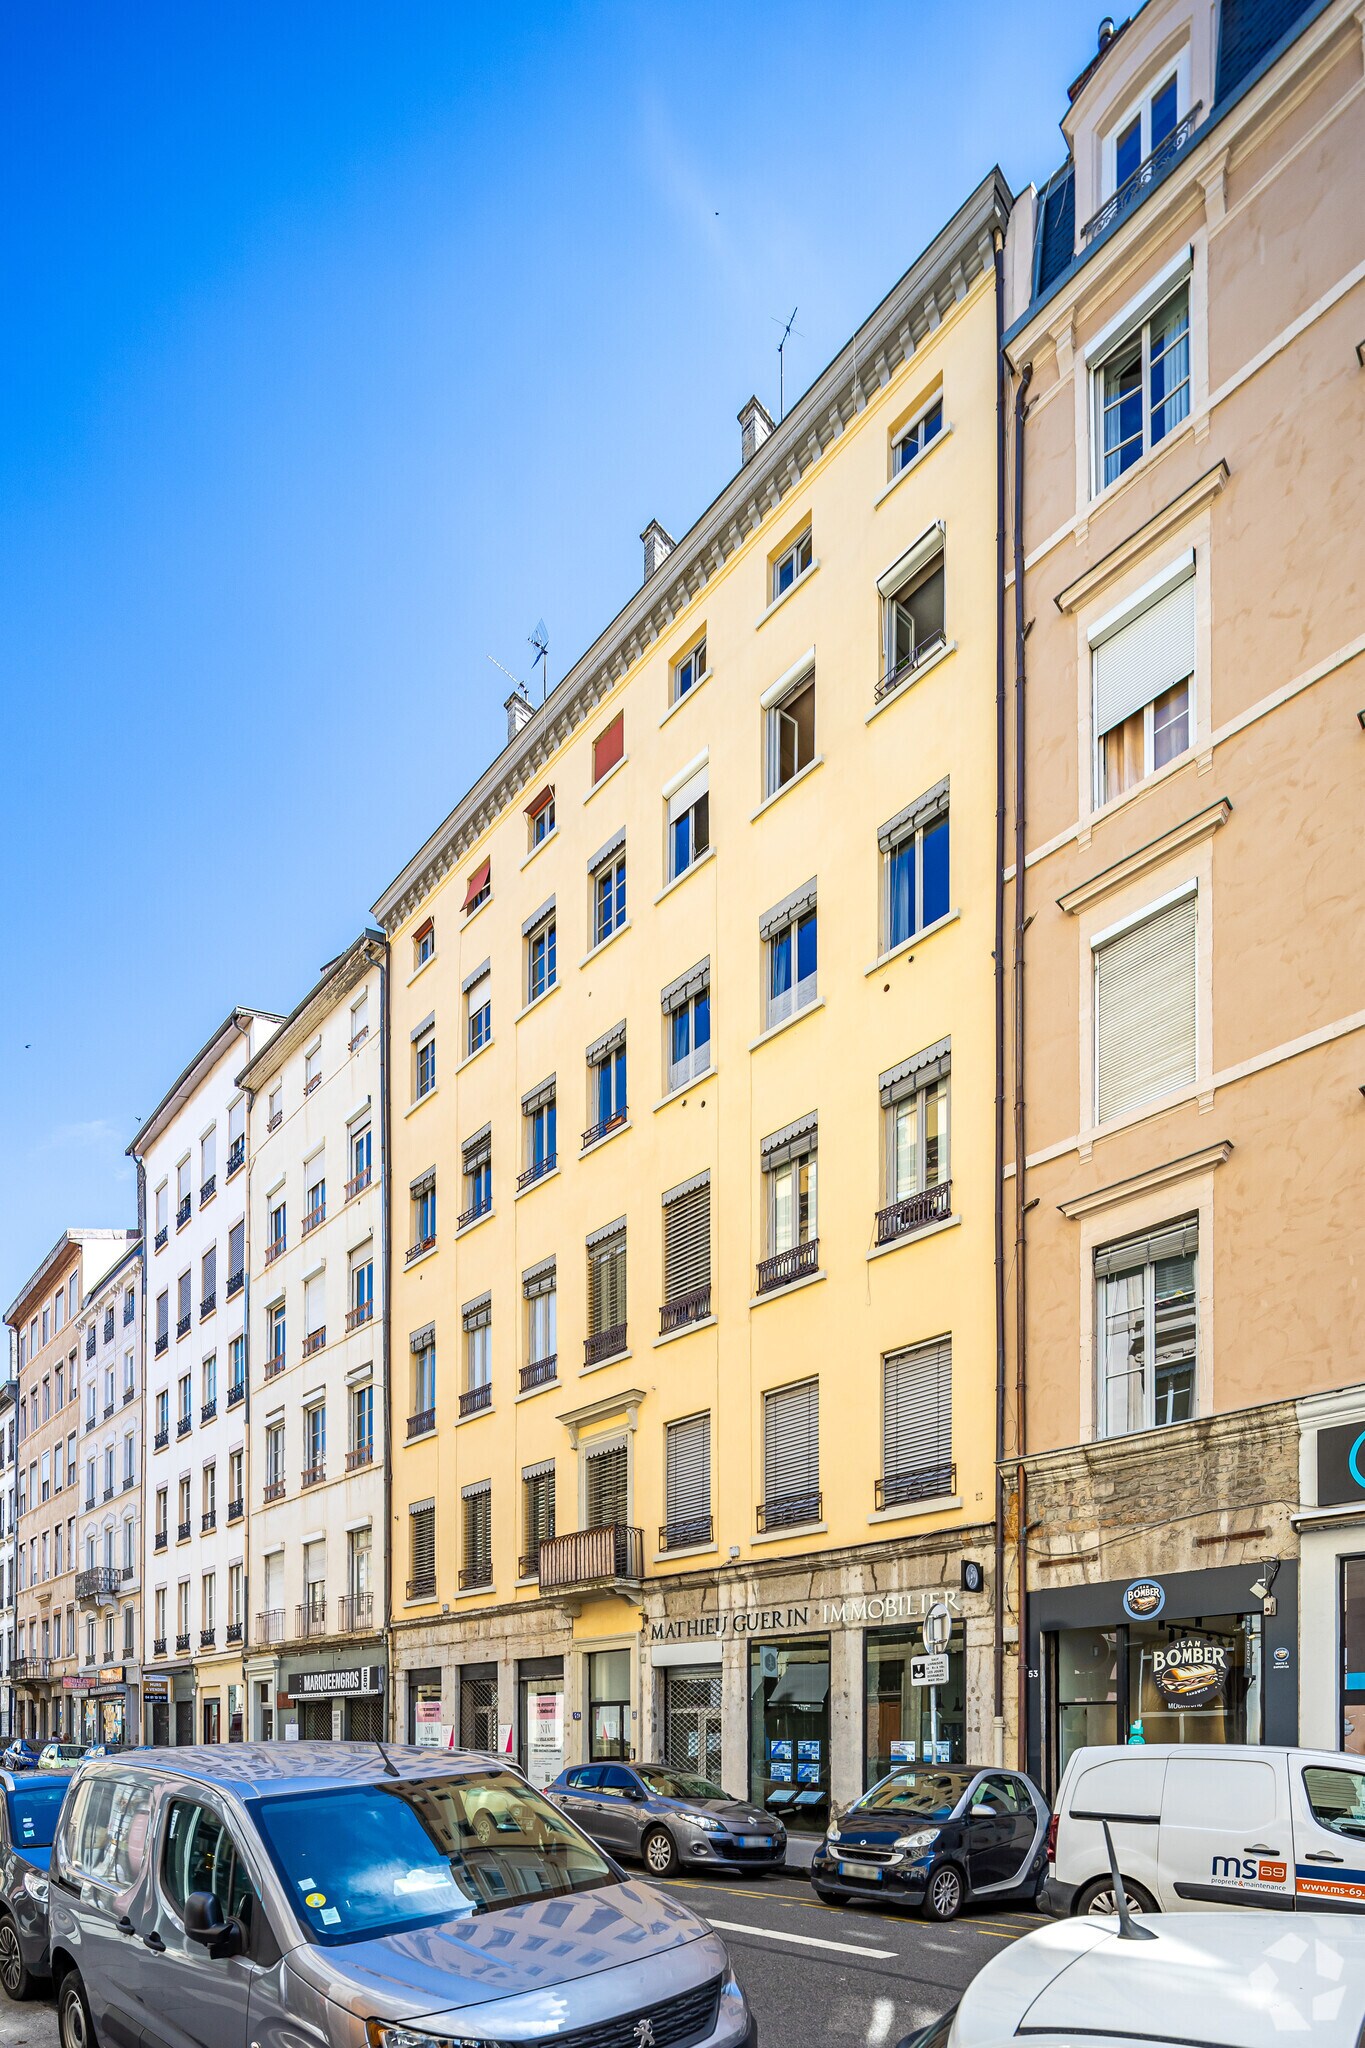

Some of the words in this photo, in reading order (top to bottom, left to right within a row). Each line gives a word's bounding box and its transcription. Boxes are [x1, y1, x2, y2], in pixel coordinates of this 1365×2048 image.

[1127, 1587, 1160, 1601] BOMBER
[650, 1616, 728, 1640] MATHIEU
[732, 1606, 809, 1632] GUERIN
[822, 1591, 961, 1624] IMMOBILIER
[1174, 1640, 1201, 1649] JEAN
[1152, 1646, 1227, 1673] BOMBER
[303, 1671, 360, 1692] MARQUEENGROS
[1028, 1669, 1039, 1678] 53
